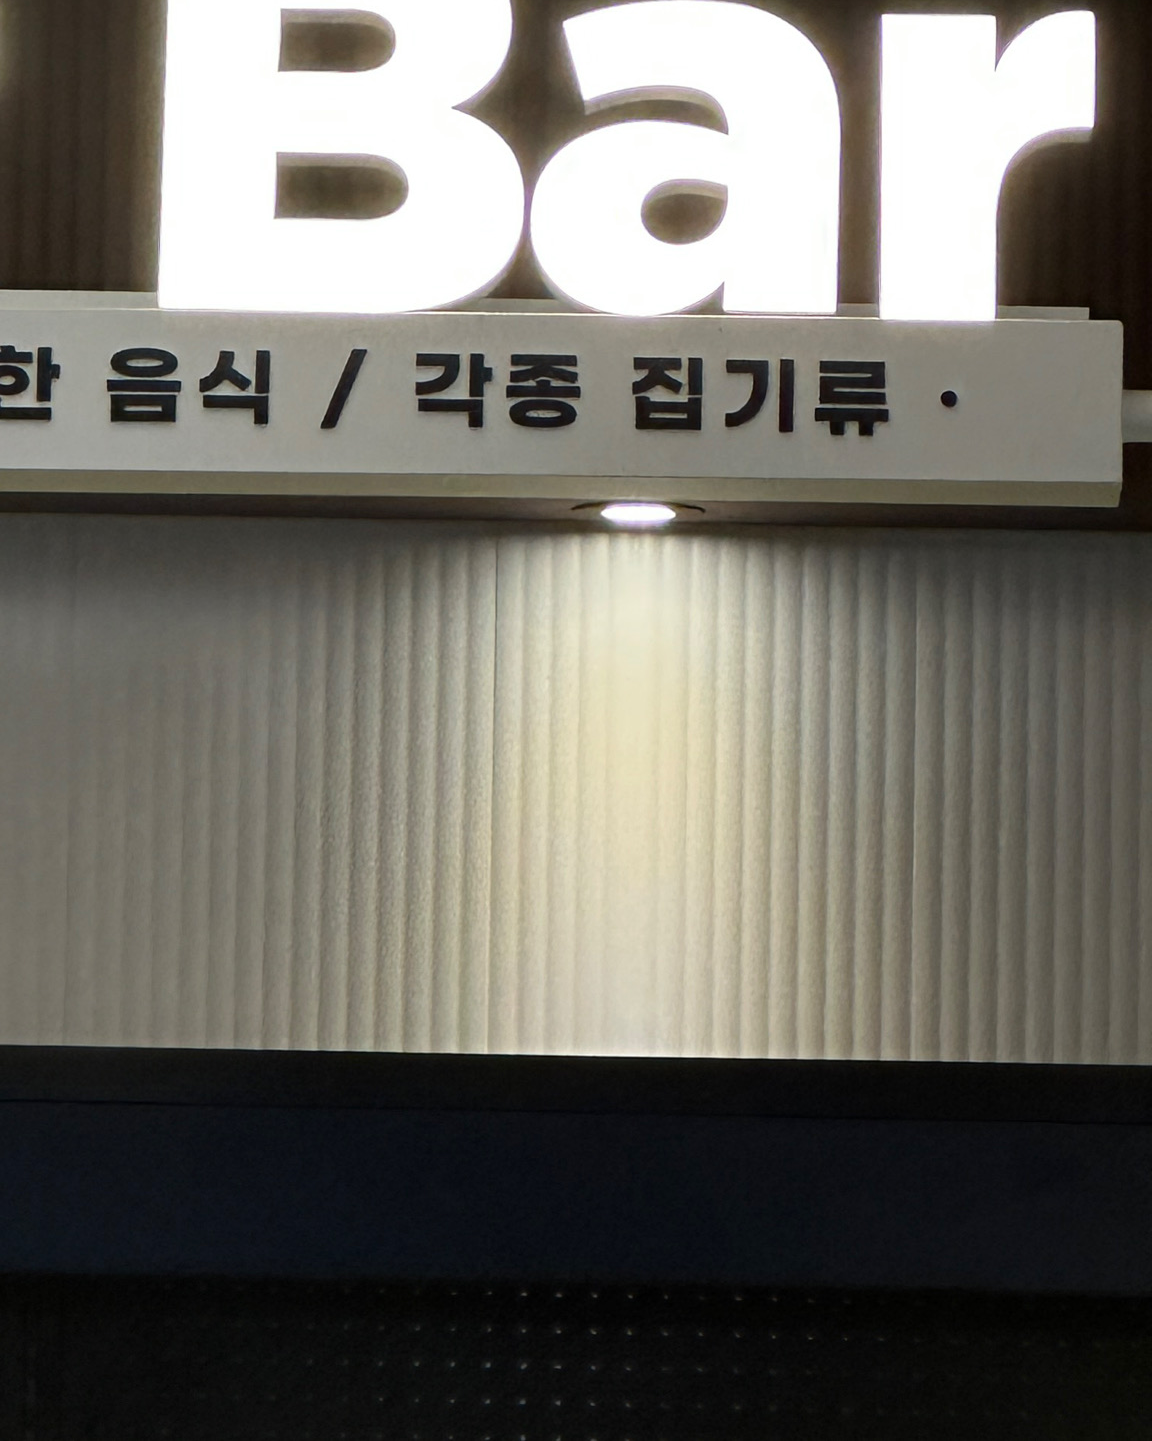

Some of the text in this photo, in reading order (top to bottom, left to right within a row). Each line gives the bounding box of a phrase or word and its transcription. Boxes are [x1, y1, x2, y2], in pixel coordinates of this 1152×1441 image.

[106, 347, 271, 430] 음식
[415, 353, 582, 429] 각종
[631, 356, 890, 438] 집기류
